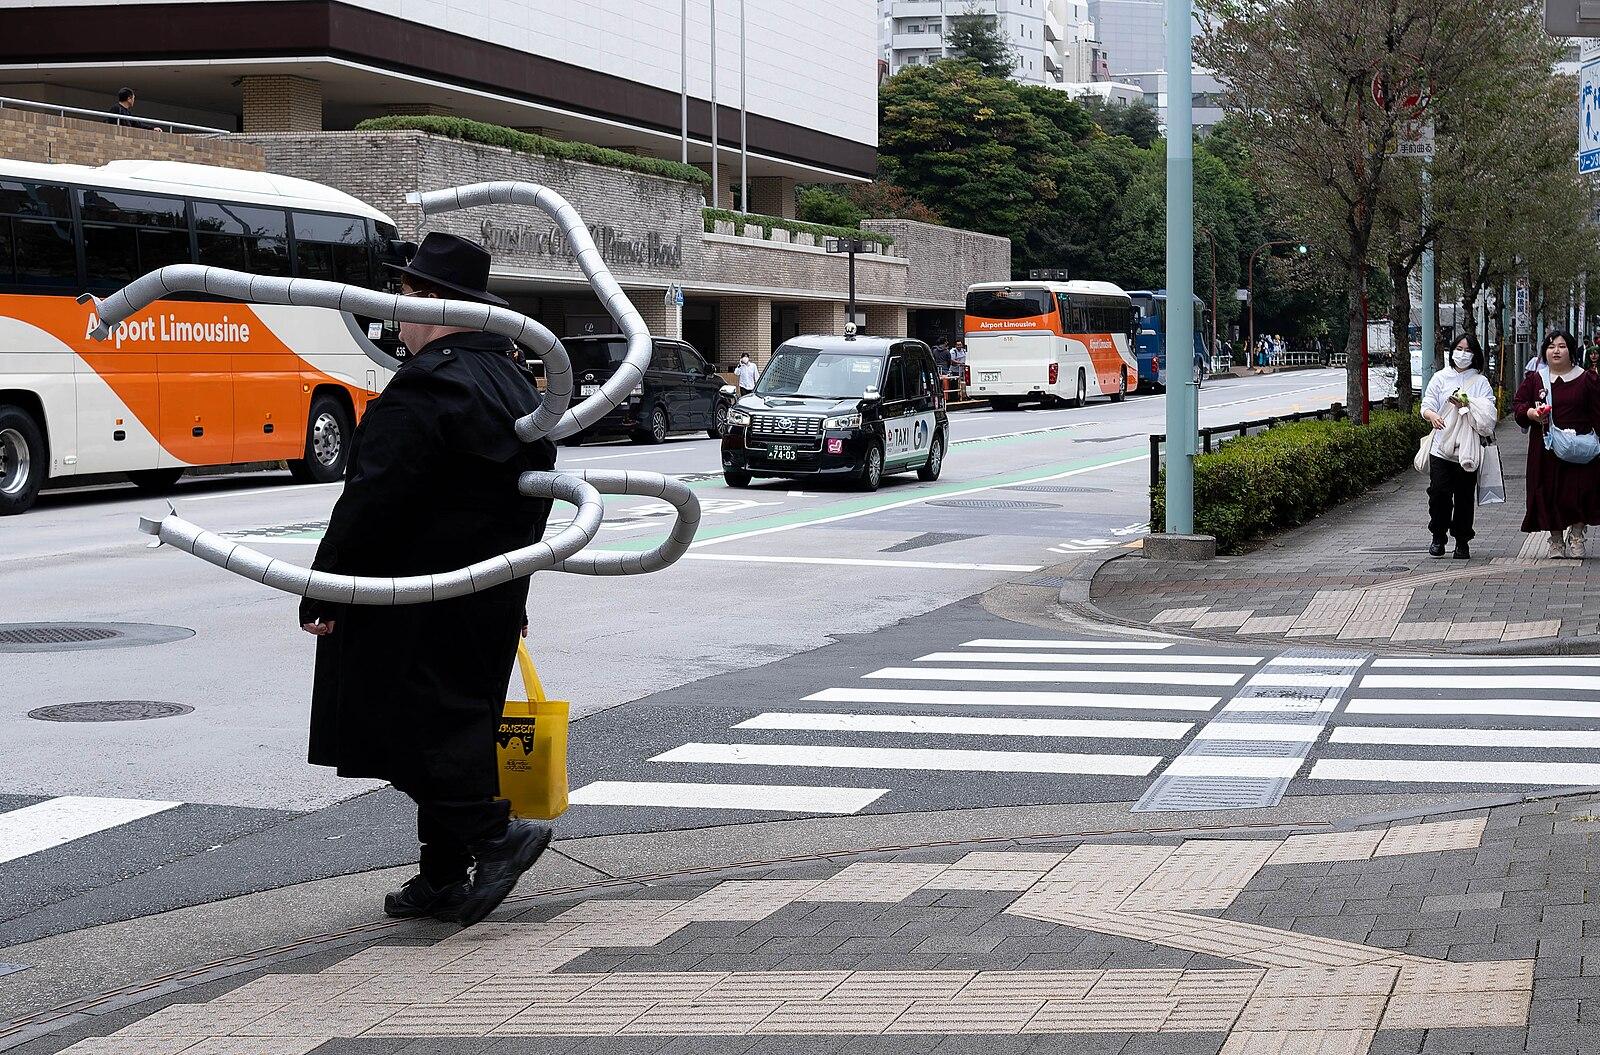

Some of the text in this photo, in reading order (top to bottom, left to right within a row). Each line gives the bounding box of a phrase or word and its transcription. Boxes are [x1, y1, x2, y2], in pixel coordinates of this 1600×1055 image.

[160, 313, 250, 343] Limousine
[980, 321, 1037, 330] Airport Limousine
[894, 428, 909, 447] TAXI
[773, 450, 796, 460] 74-03
